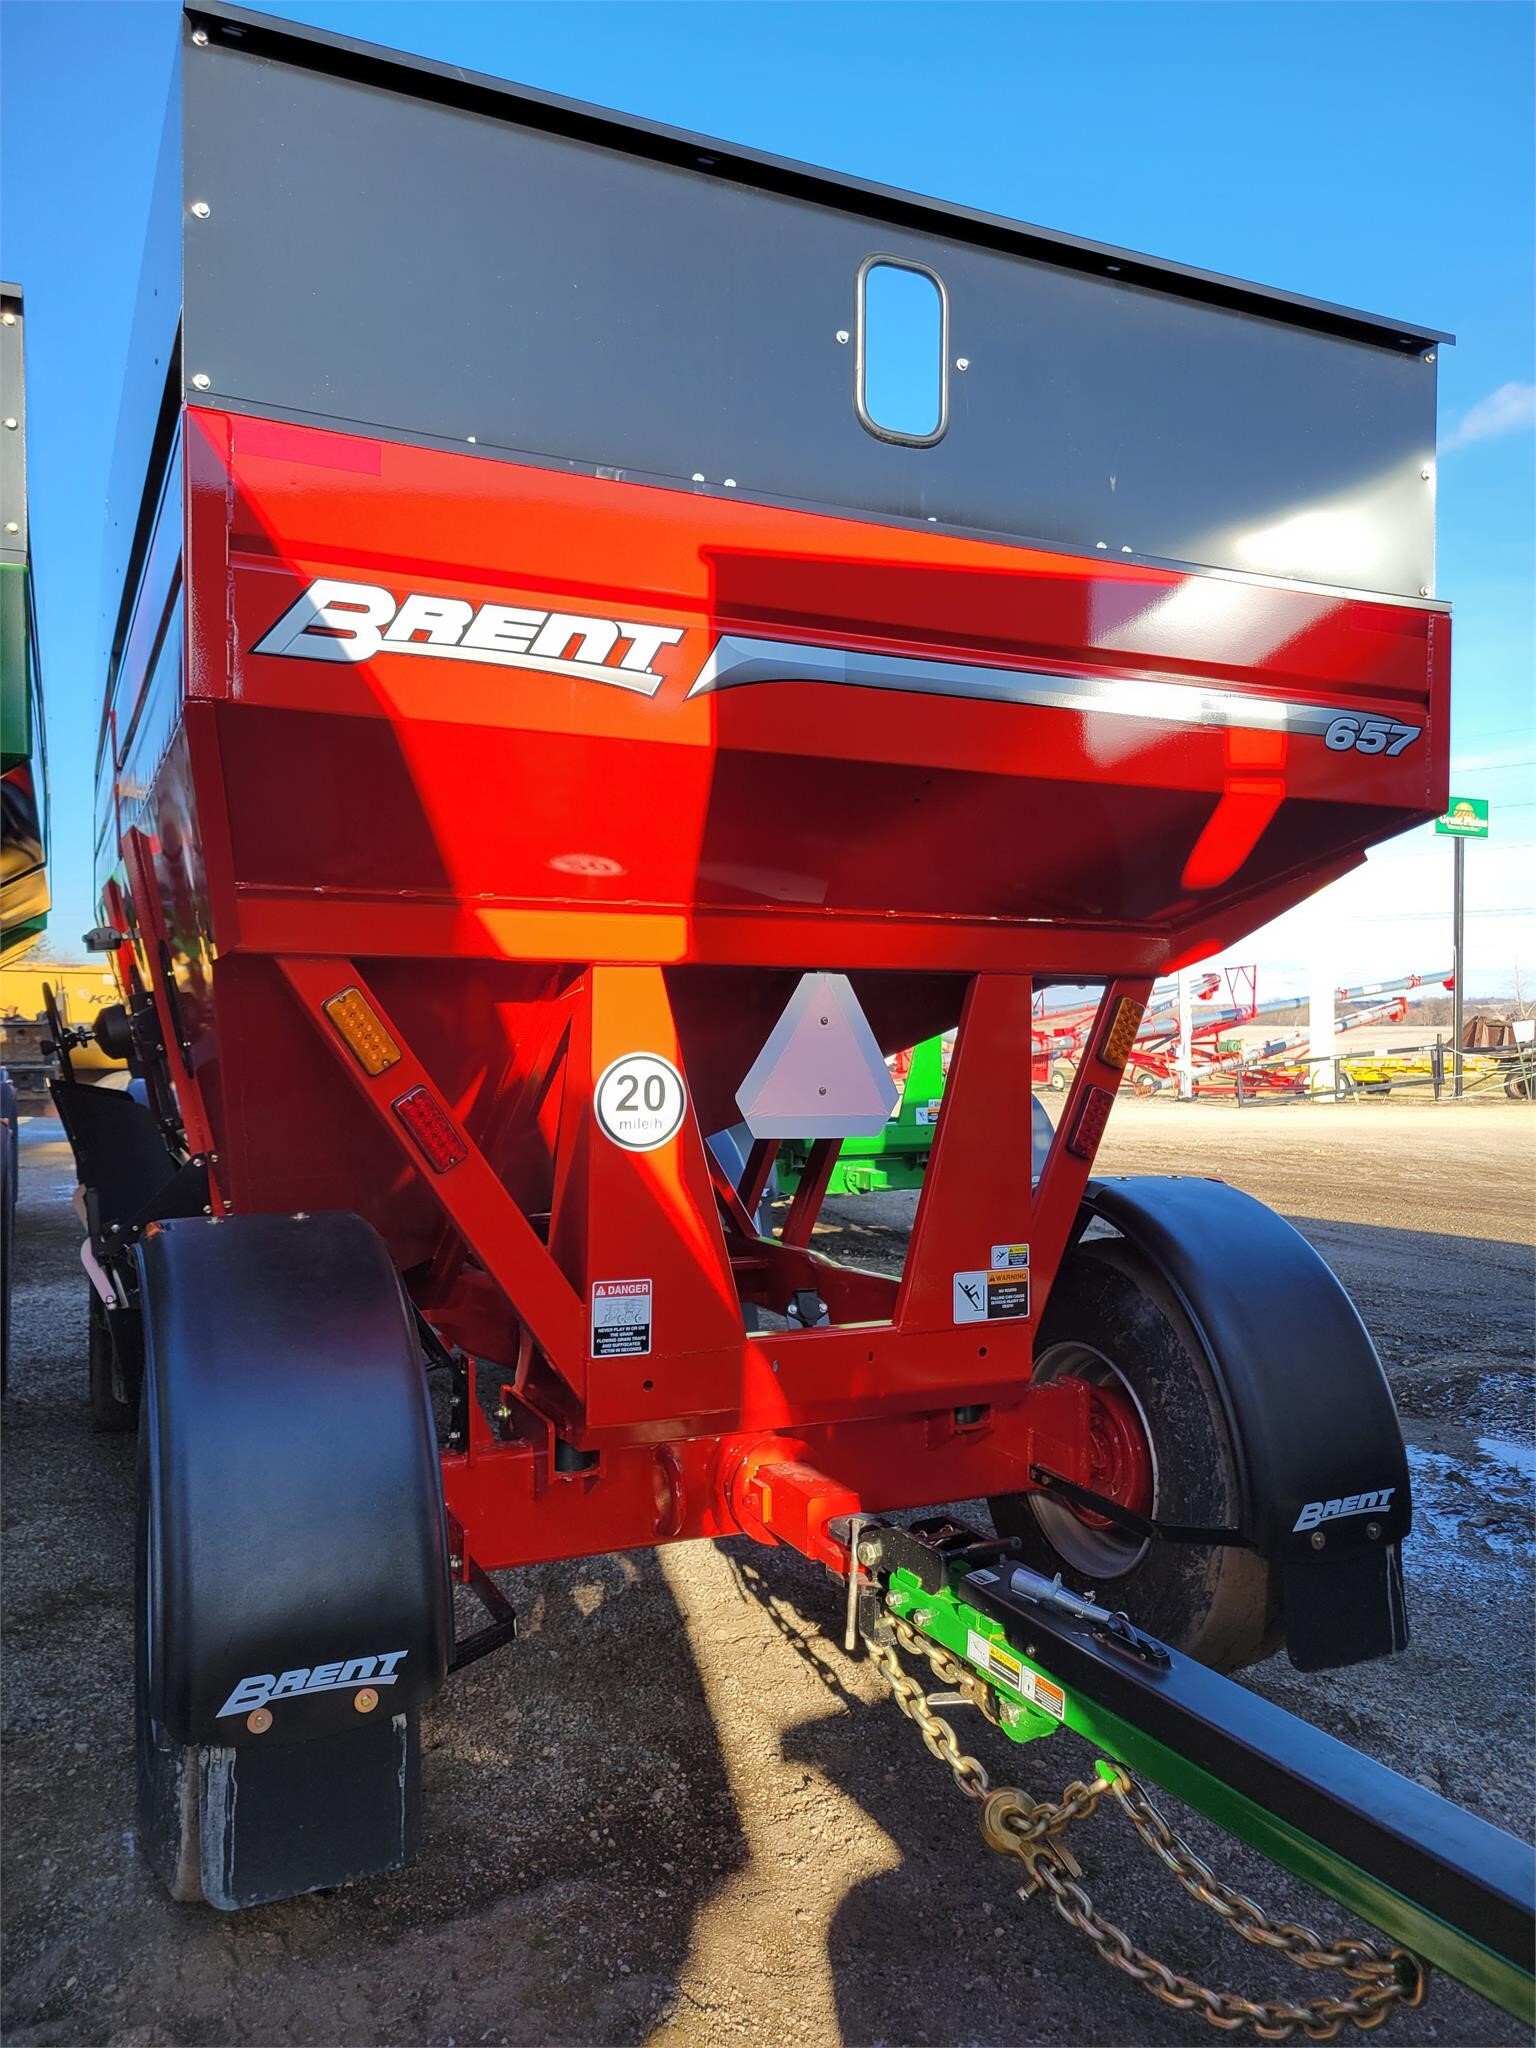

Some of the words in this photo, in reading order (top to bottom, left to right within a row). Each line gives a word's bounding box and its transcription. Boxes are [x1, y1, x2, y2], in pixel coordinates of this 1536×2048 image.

[252, 578, 686, 698] BRENT
[1325, 717, 1420, 755] 657
[616, 1075, 665, 1111] 20
[619, 1118, 662, 1130] mile/h
[608, 1284, 648, 1295] DANGER
[1292, 1487, 1396, 1532] BRENT
[215, 1650, 409, 1718] BRENT
